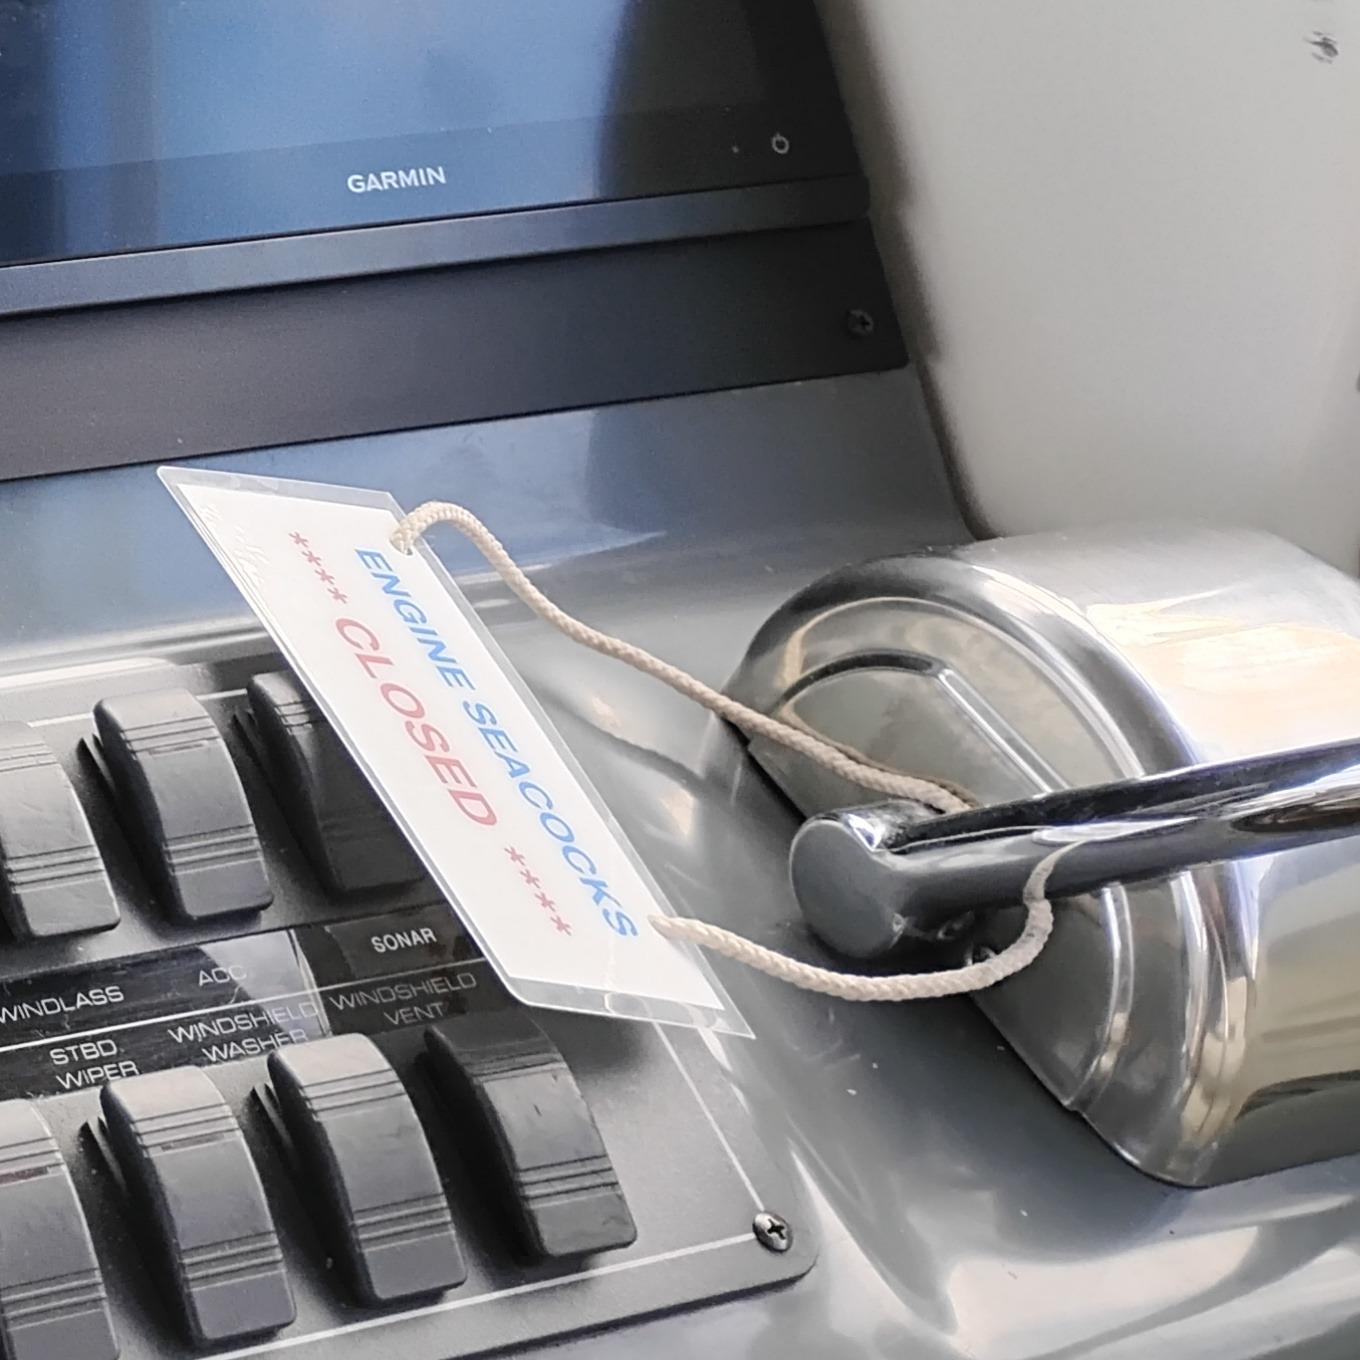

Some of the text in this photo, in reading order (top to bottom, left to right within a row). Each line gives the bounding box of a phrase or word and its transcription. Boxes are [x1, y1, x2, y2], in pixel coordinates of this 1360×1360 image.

[347, 166, 446, 194] GARMIN
[335, 617, 498, 827] CLOSED
[356, 548, 638, 938] ENGINE SEACOCKS
[370, 927, 437, 954] SONAR
[197, 963, 248, 988] ACC
[330, 971, 478, 1010] WINDSHIELD
[168, 1002, 320, 1045] WINDSHIELD
[383, 1001, 445, 1027] VENT
[49, 1038, 125, 1066] STBD.
[202, 1028, 312, 1064] WASHER
[55, 1061, 141, 1090] WIPER
